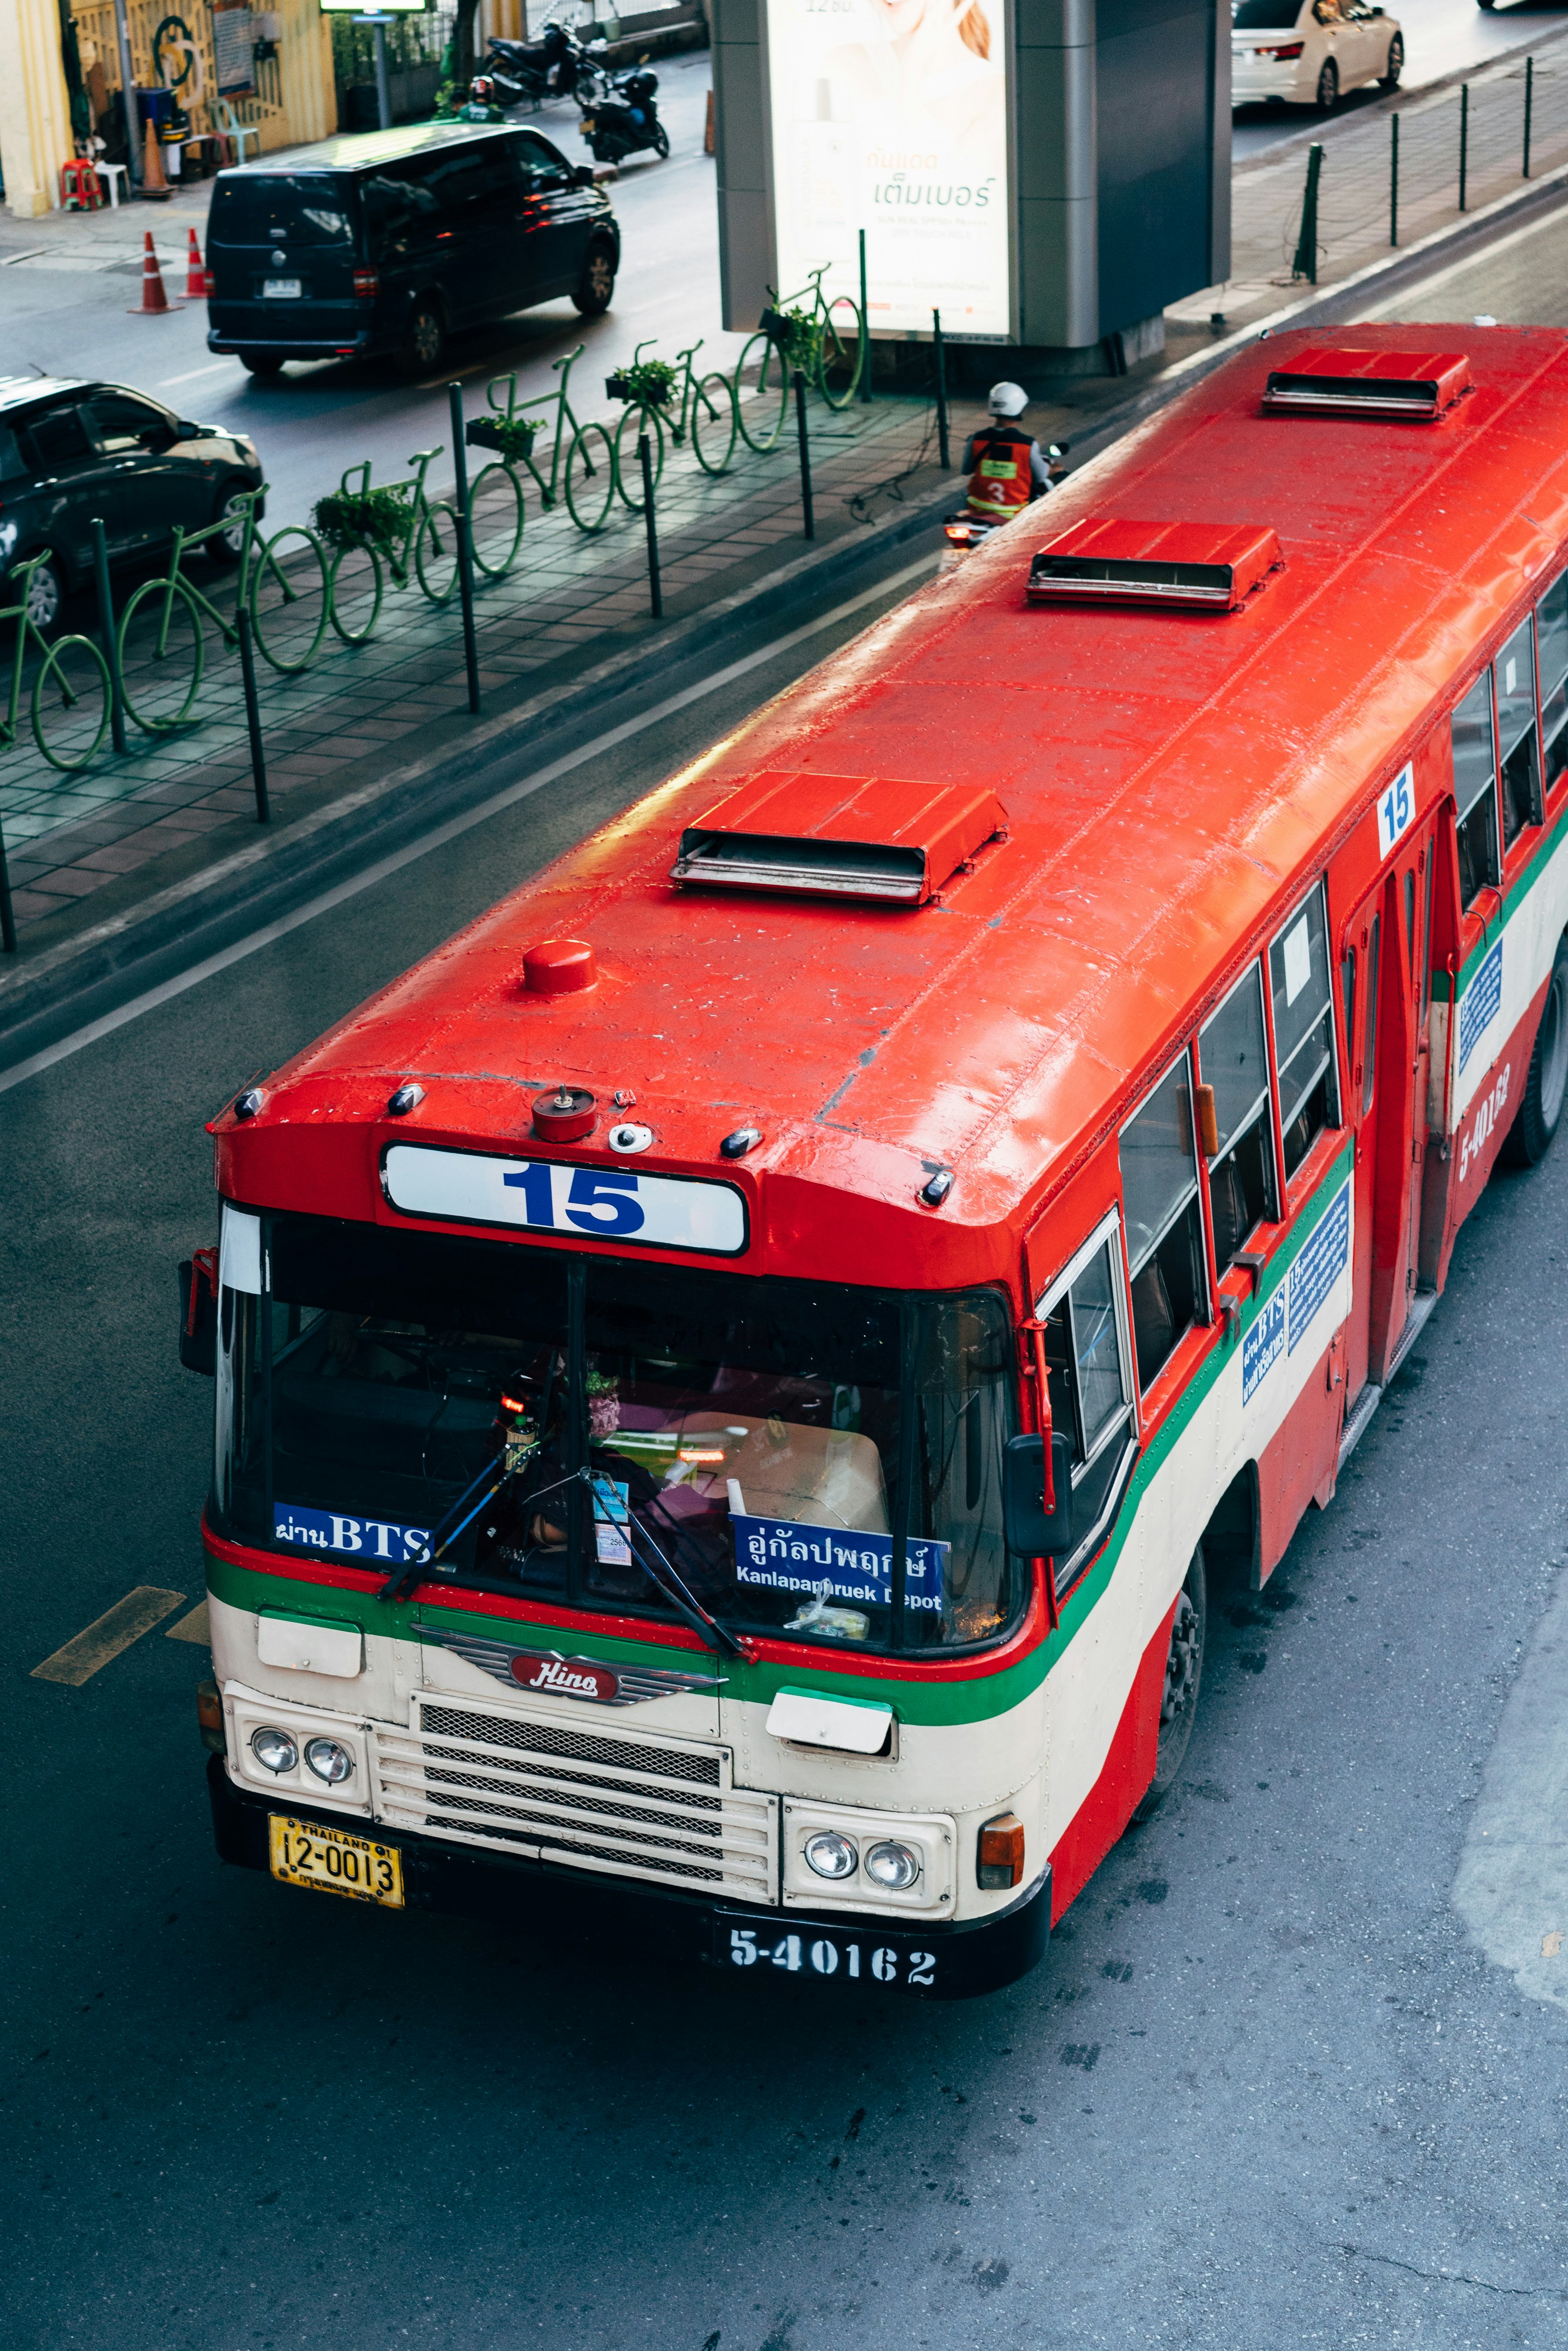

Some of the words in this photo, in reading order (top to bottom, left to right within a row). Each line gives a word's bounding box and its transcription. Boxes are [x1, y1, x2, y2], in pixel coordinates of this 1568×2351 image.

[867, 148, 938, 170] กันแดด
[874, 173, 997, 208] เต็มเบอร์
[1385, 771, 1409, 842] 15
[1459, 1062, 1510, 1183] 5-40162
[503, 1163, 645, 1235] 15
[748, 1527, 929, 1578] อู่กัลปพฤกษ์
[737, 1566, 877, 1601] Kanlapaphruek
[530, 1662, 599, 1697] Hino
[283, 1833, 394, 1892] 12-0013
[301, 1824, 370, 1852] THAILAND
[730, 1929, 937, 1986] 5-40162
